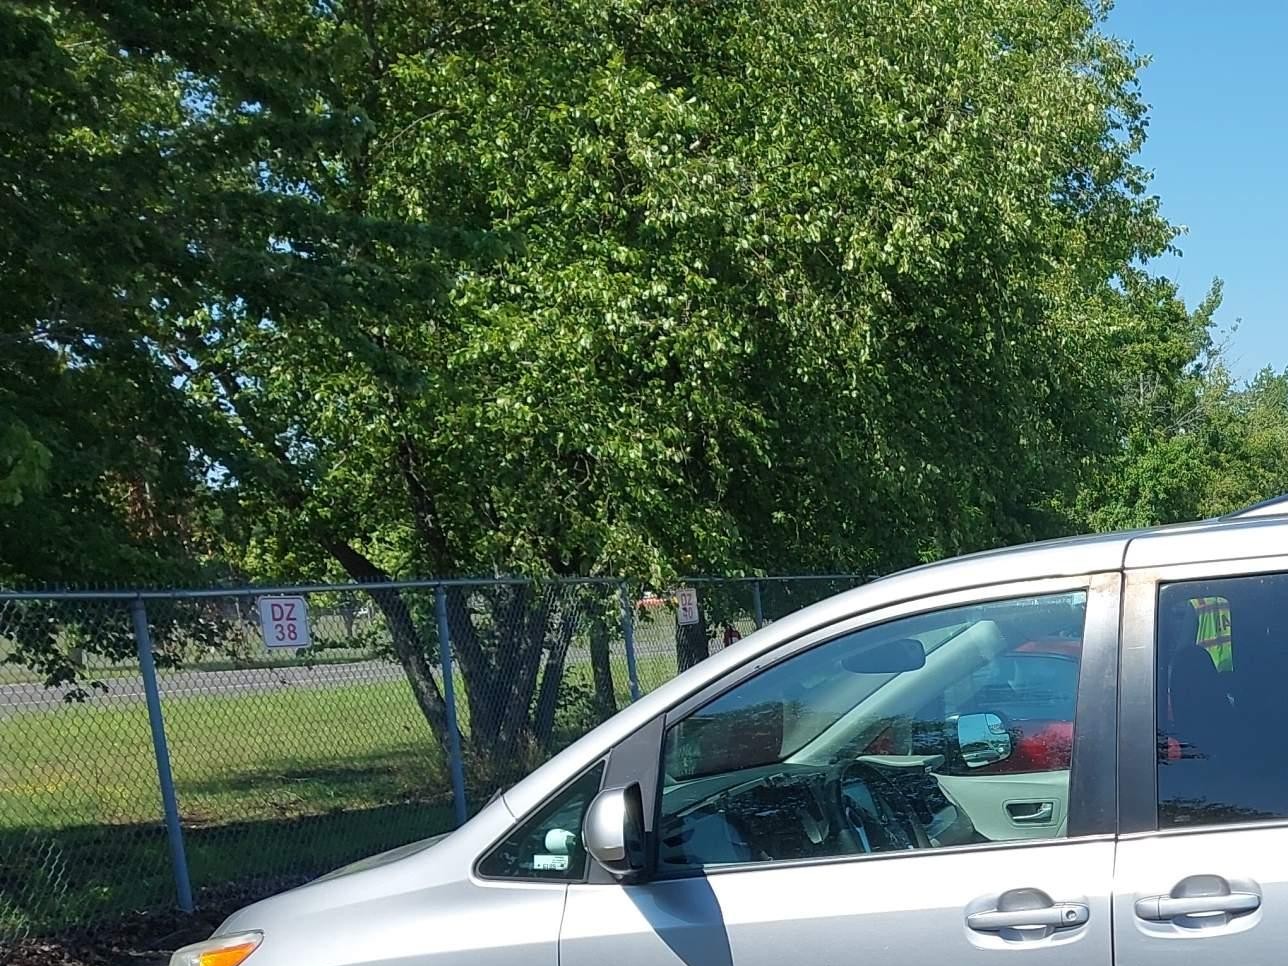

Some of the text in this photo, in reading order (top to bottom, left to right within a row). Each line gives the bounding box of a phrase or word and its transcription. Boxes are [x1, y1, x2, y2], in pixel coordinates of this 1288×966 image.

[680, 593, 693, 606] DZ
[270, 603, 297, 622] DZ
[274, 623, 298, 642] 38
